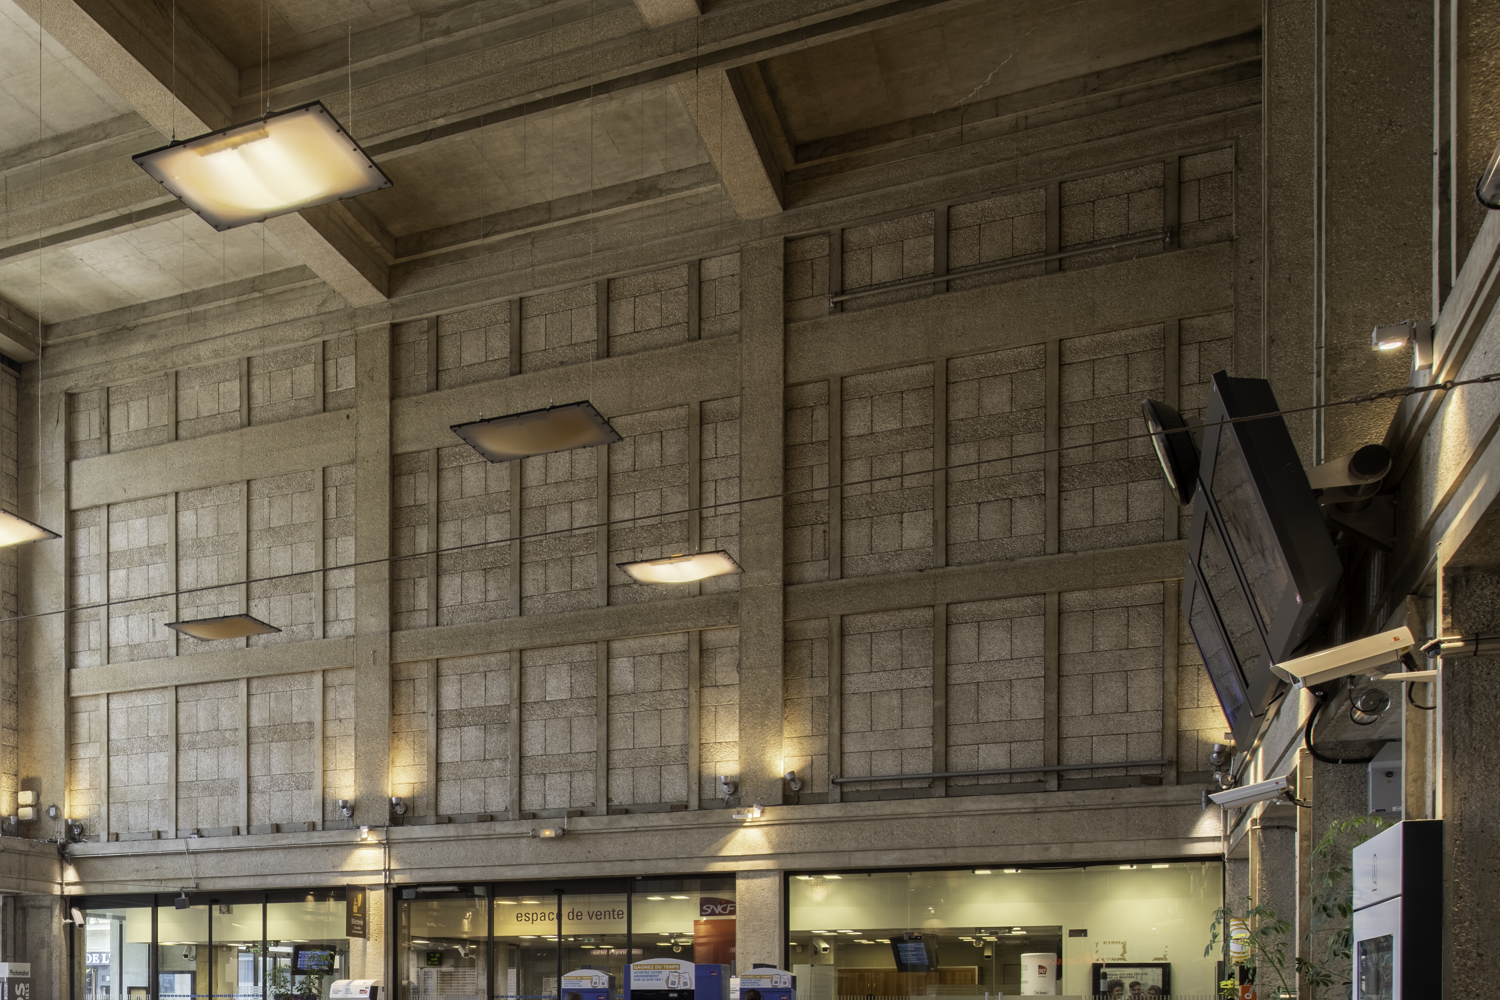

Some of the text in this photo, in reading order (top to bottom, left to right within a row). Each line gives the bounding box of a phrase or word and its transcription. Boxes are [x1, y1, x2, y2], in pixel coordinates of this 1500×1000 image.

[567, 907, 583, 921] de
[587, 907, 625, 921] vente
[701, 903, 737, 915] SNCF
